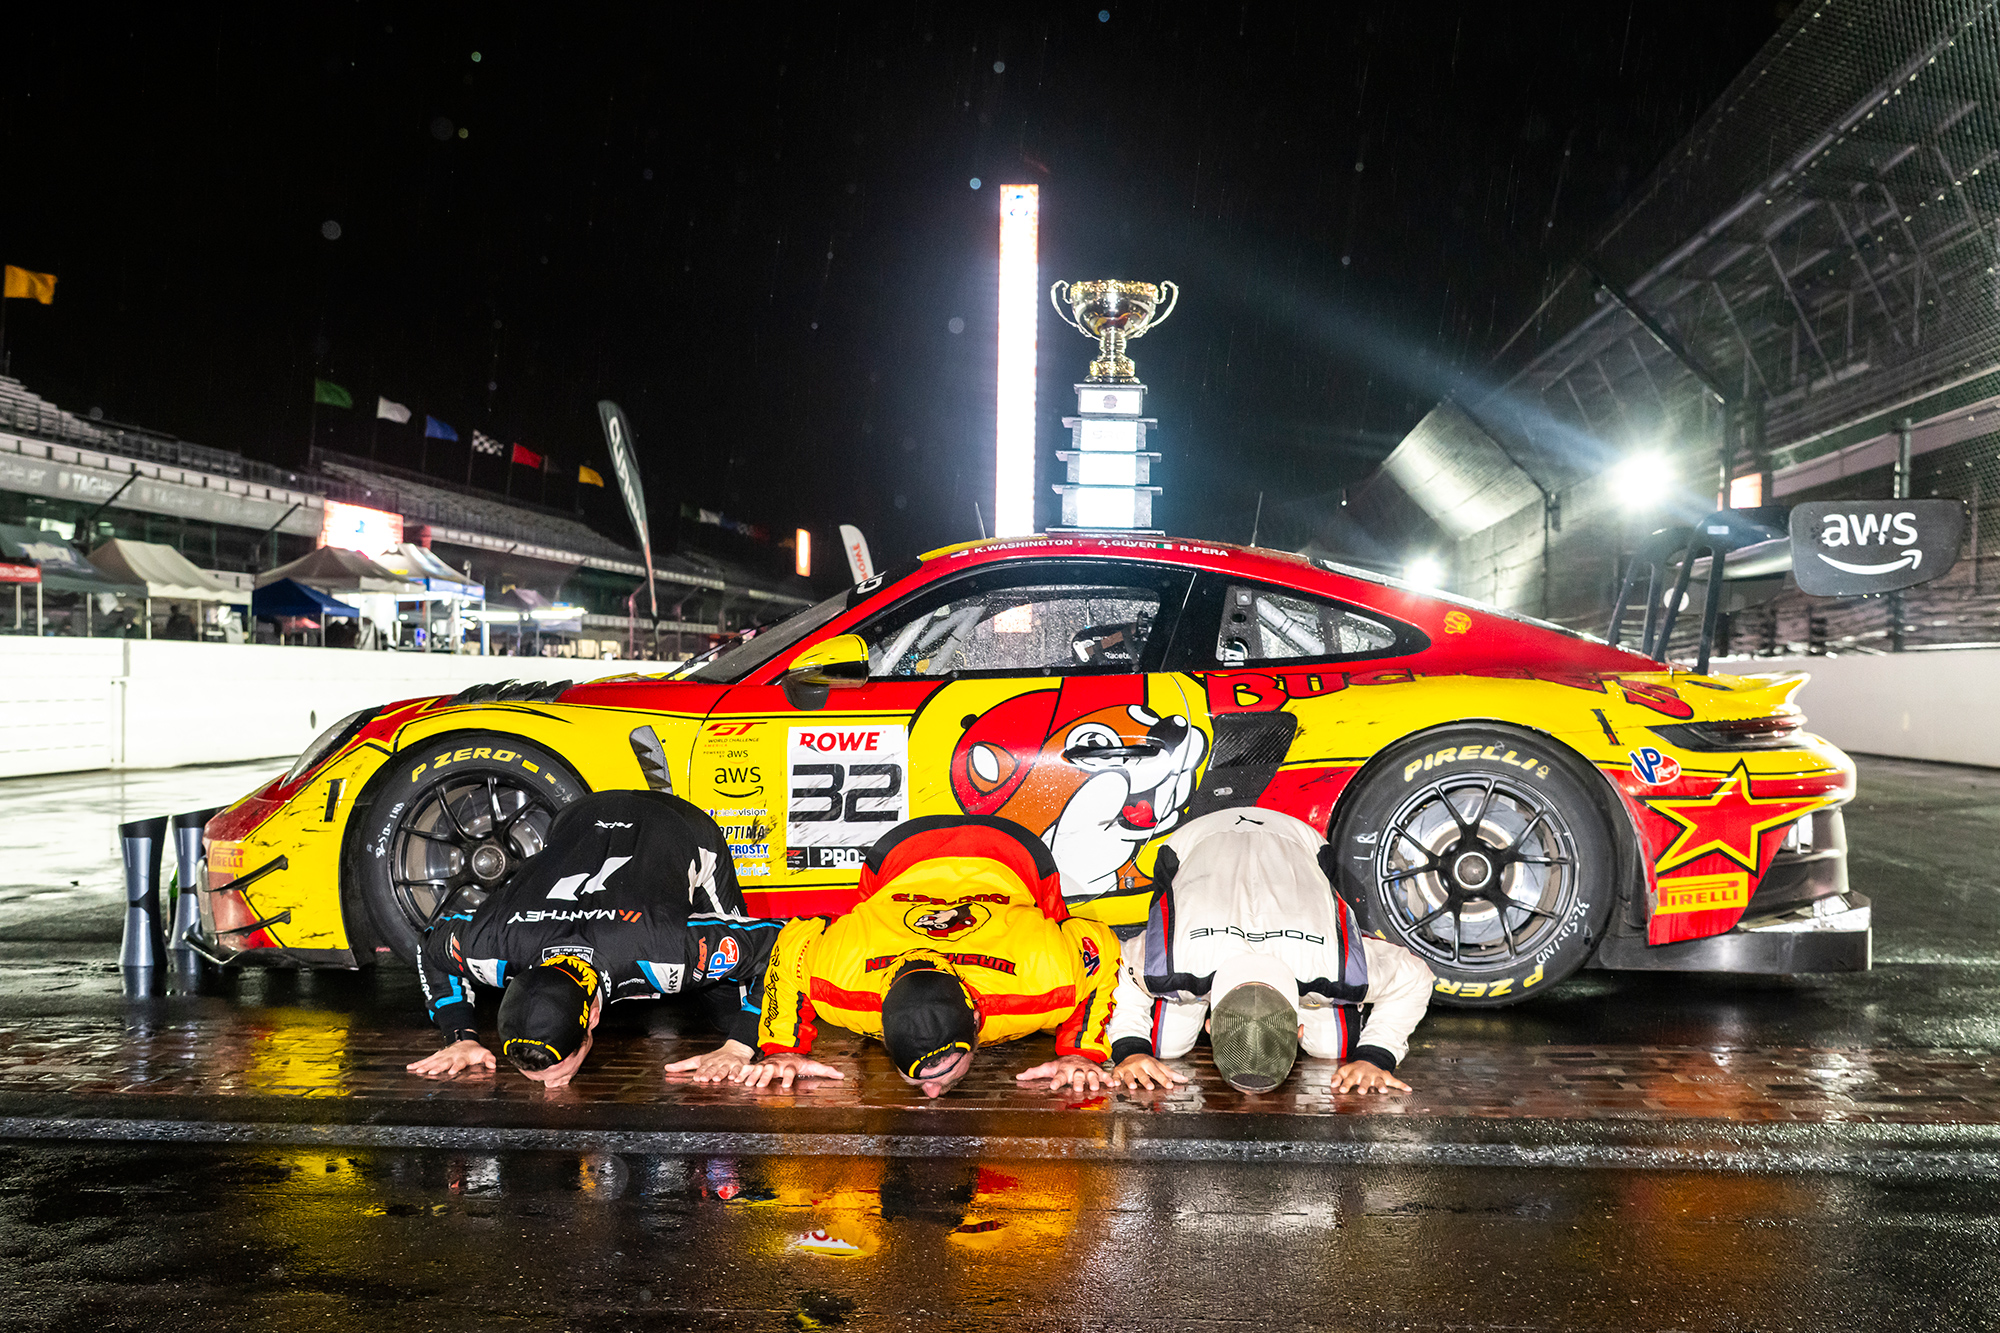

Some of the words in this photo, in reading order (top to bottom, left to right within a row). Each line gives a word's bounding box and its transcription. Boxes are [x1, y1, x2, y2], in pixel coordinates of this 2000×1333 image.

[1821, 511, 1919, 547] aws
[974, 539, 1073, 554] K.WASHINGTON
[1179, 544, 1229, 557] R.PERA
[799, 731, 881, 752] ROWE
[411, 762, 427, 783] P
[1404, 744, 1539, 783] PIRELLI
[1630, 748, 1663, 784] VP
[714, 766, 762, 785] aws
[788, 763, 903, 823] 32
[211, 847, 244, 868] PIRELLI
[729, 843, 770, 855] FROSTY
[1660, 880, 1740, 907] PIRELLI
[507, 909, 616, 925] MANTHEY
[1189, 926, 1325, 945] PORSCHE
[865, 952, 1018, 977] WASHON
[667, 966, 679, 991] HRX
[1432, 976, 1515, 998] ZER
[1522, 964, 1544, 988] P
